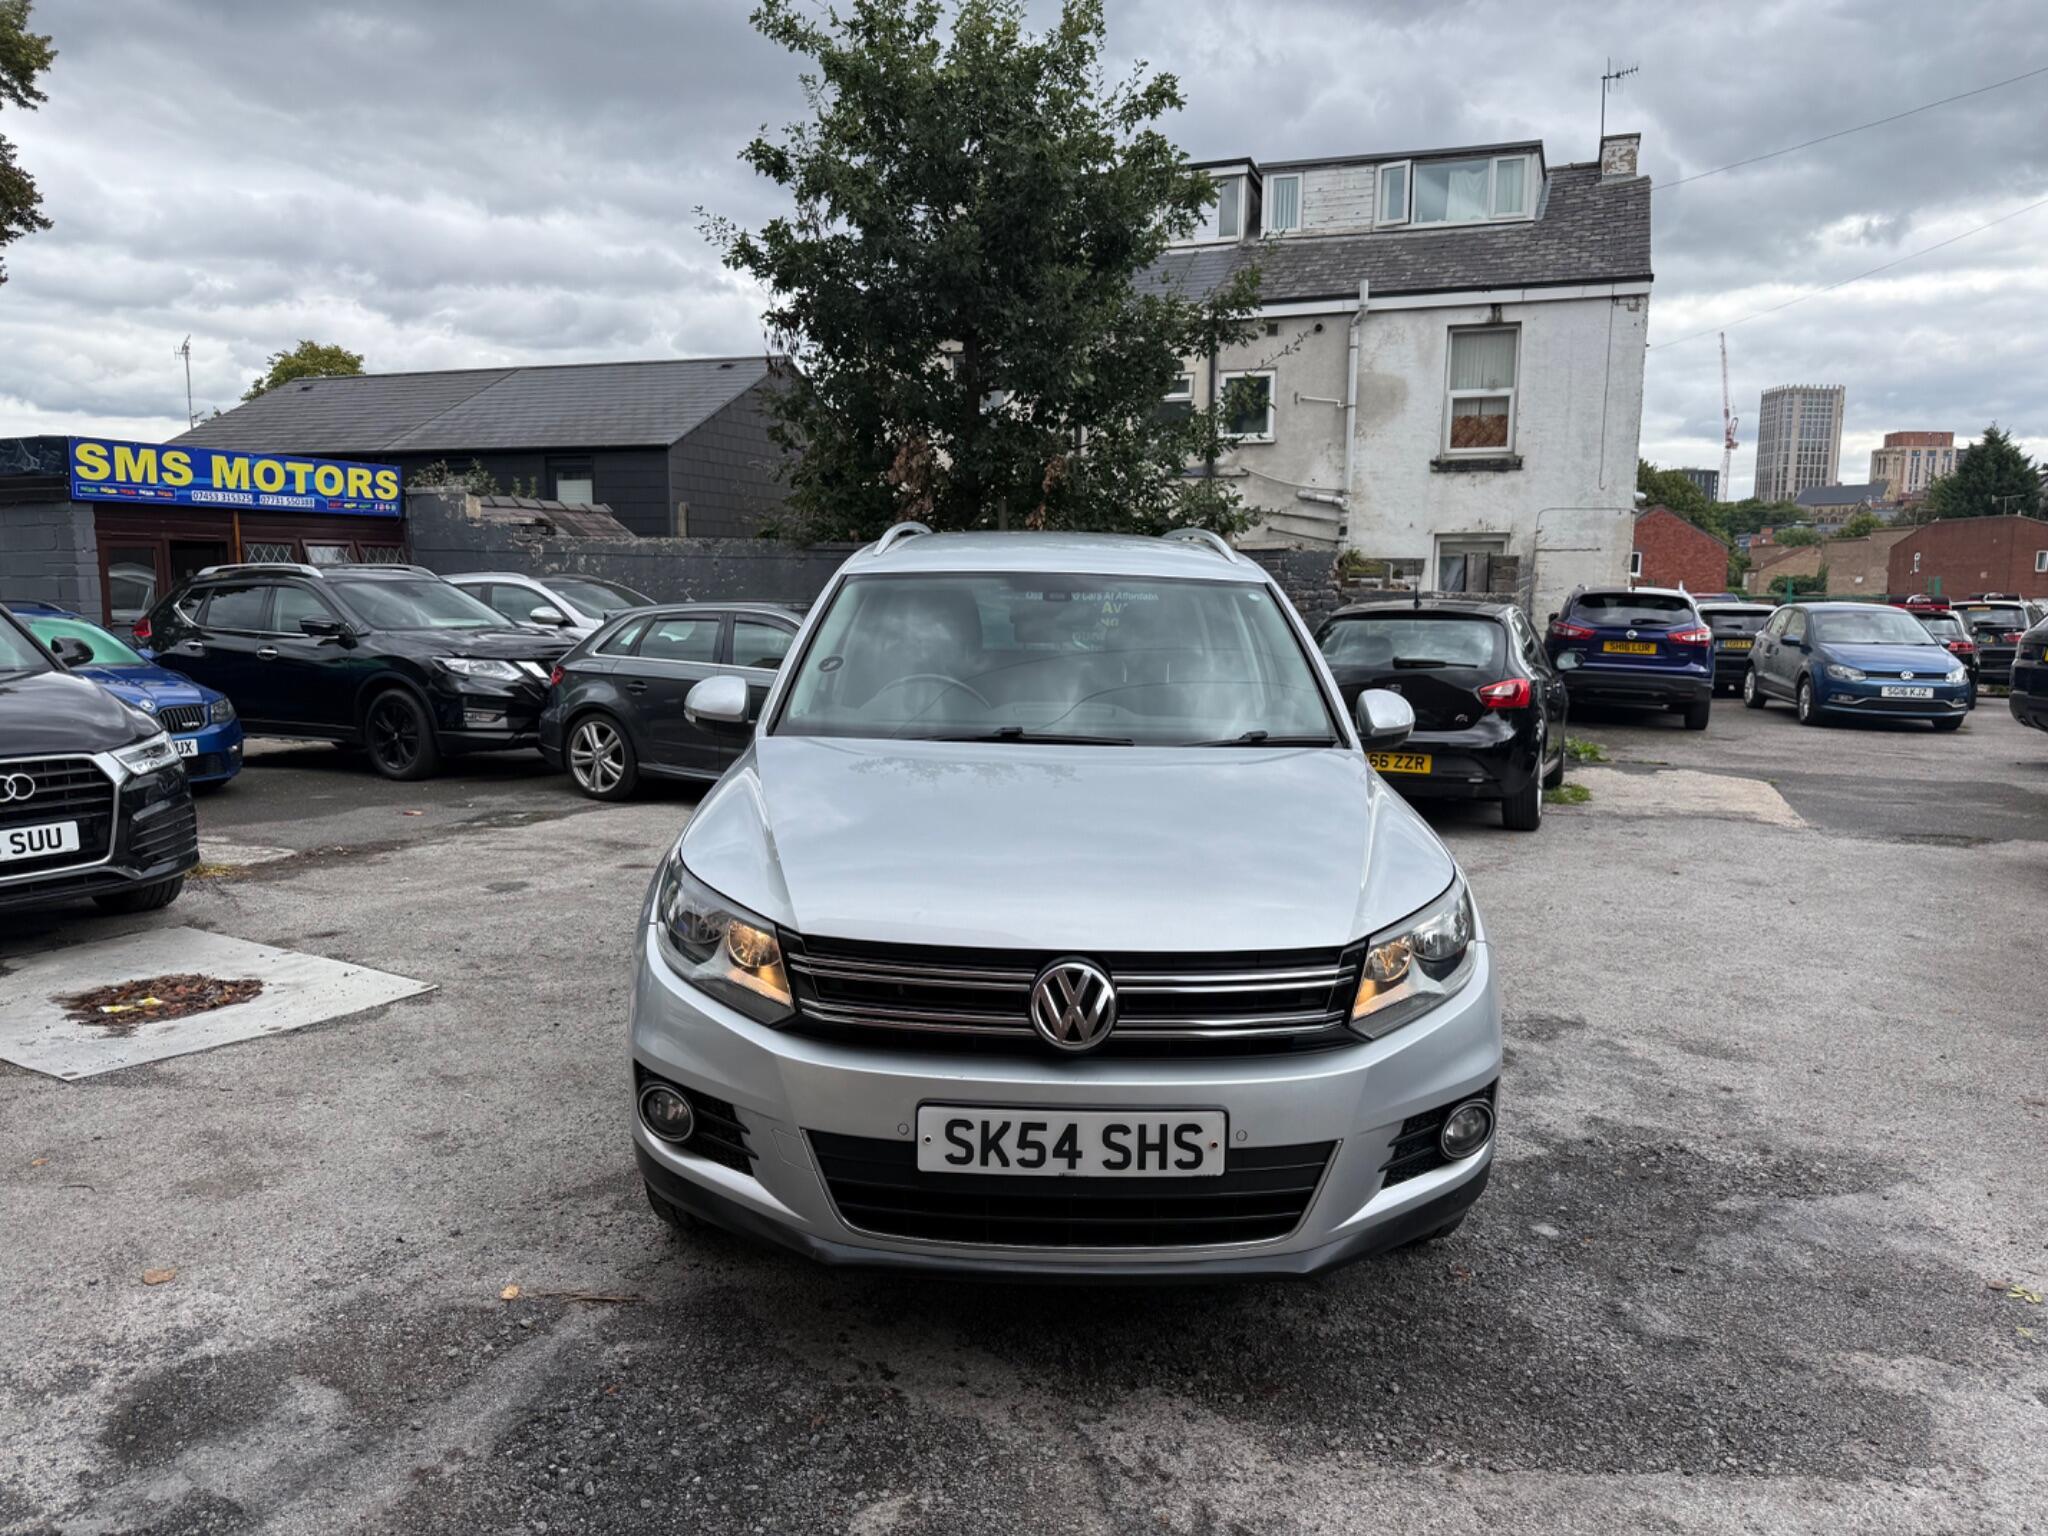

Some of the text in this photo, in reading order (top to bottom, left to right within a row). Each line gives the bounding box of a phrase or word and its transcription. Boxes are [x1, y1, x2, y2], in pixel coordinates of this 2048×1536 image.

[75, 442, 399, 501] SMS MOTORS
[1393, 755, 1425, 770] ZZR
[9, 827, 63, 855] SUU
[944, 1118, 1205, 1171] SK54 SHS
